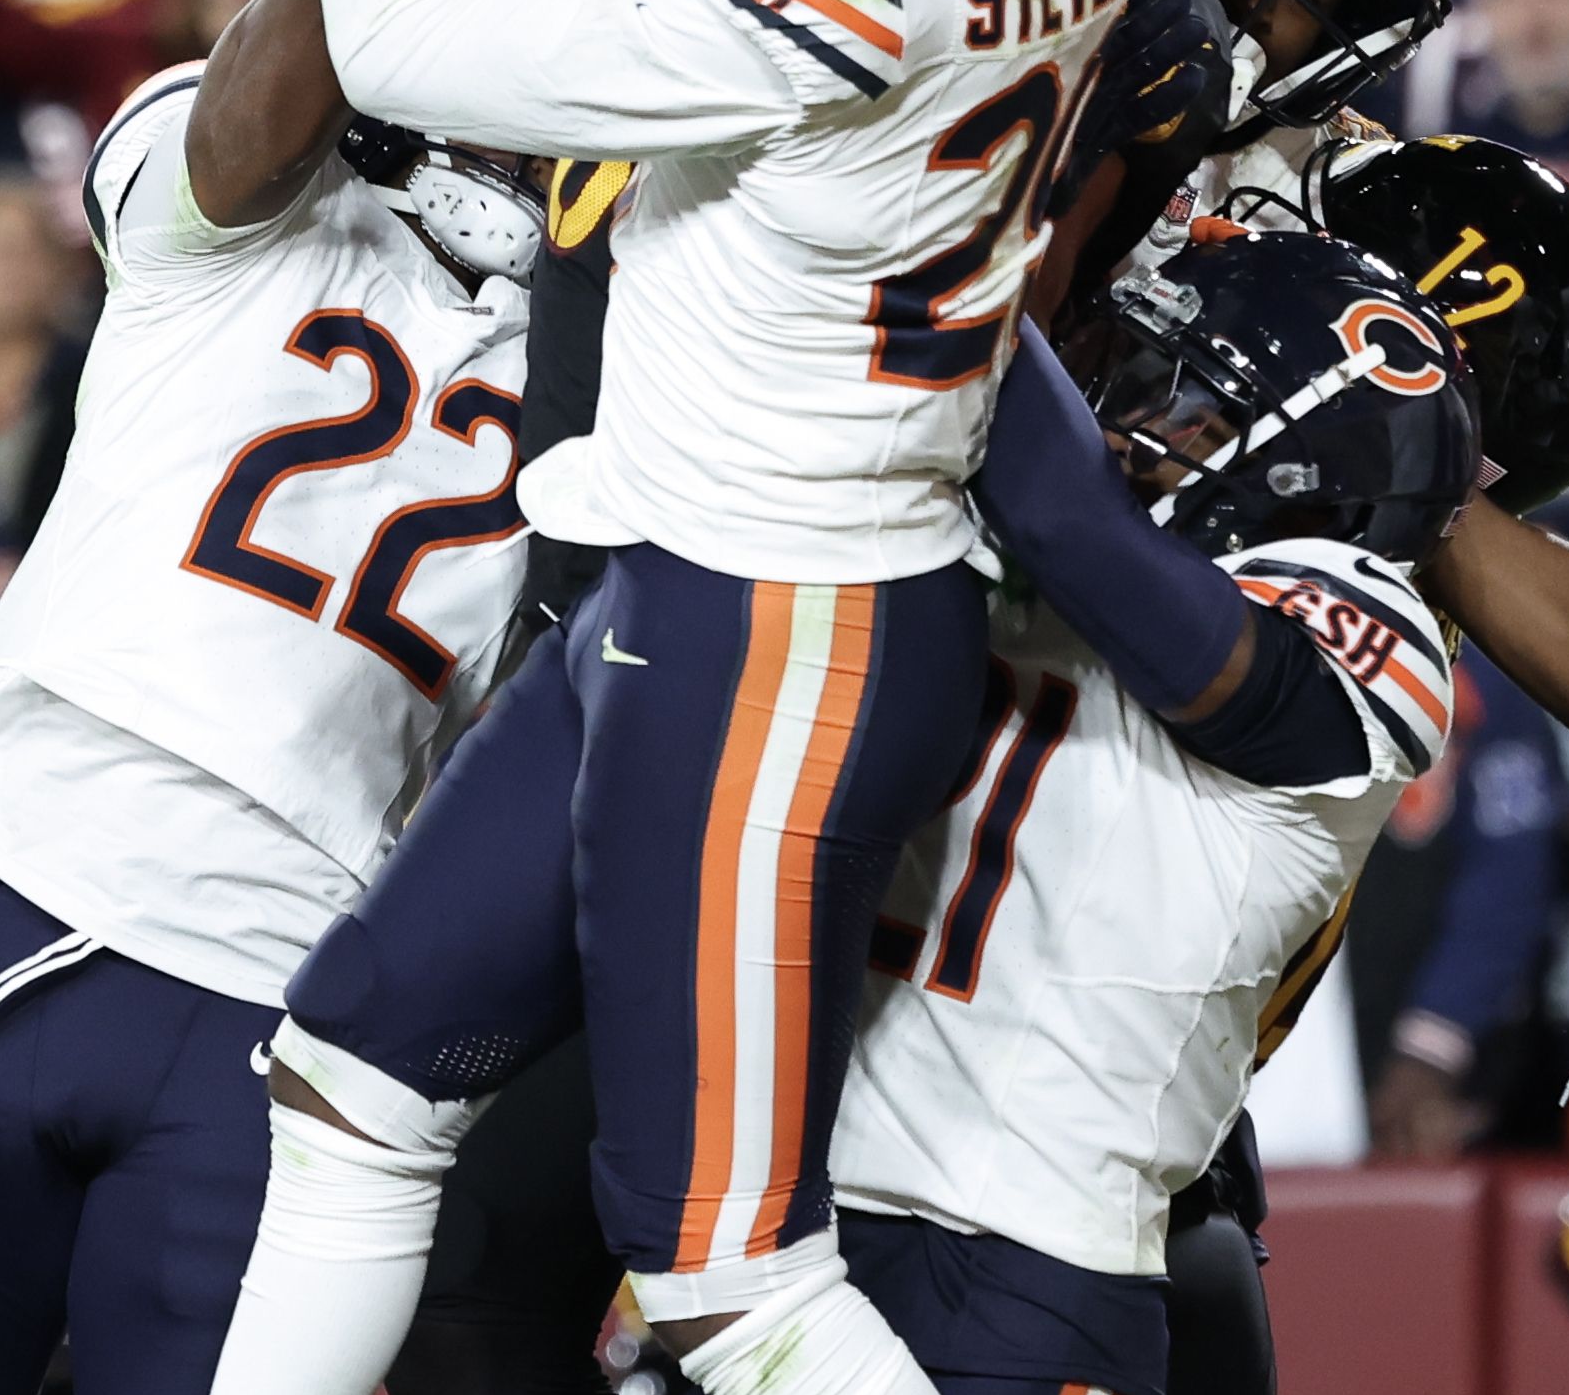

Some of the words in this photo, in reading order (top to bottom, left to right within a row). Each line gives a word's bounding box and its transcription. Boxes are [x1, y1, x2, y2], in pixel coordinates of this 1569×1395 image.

[867, 60, 1103, 392] 2
[1416, 226, 1525, 350] 12
[179, 307, 522, 703] 22
